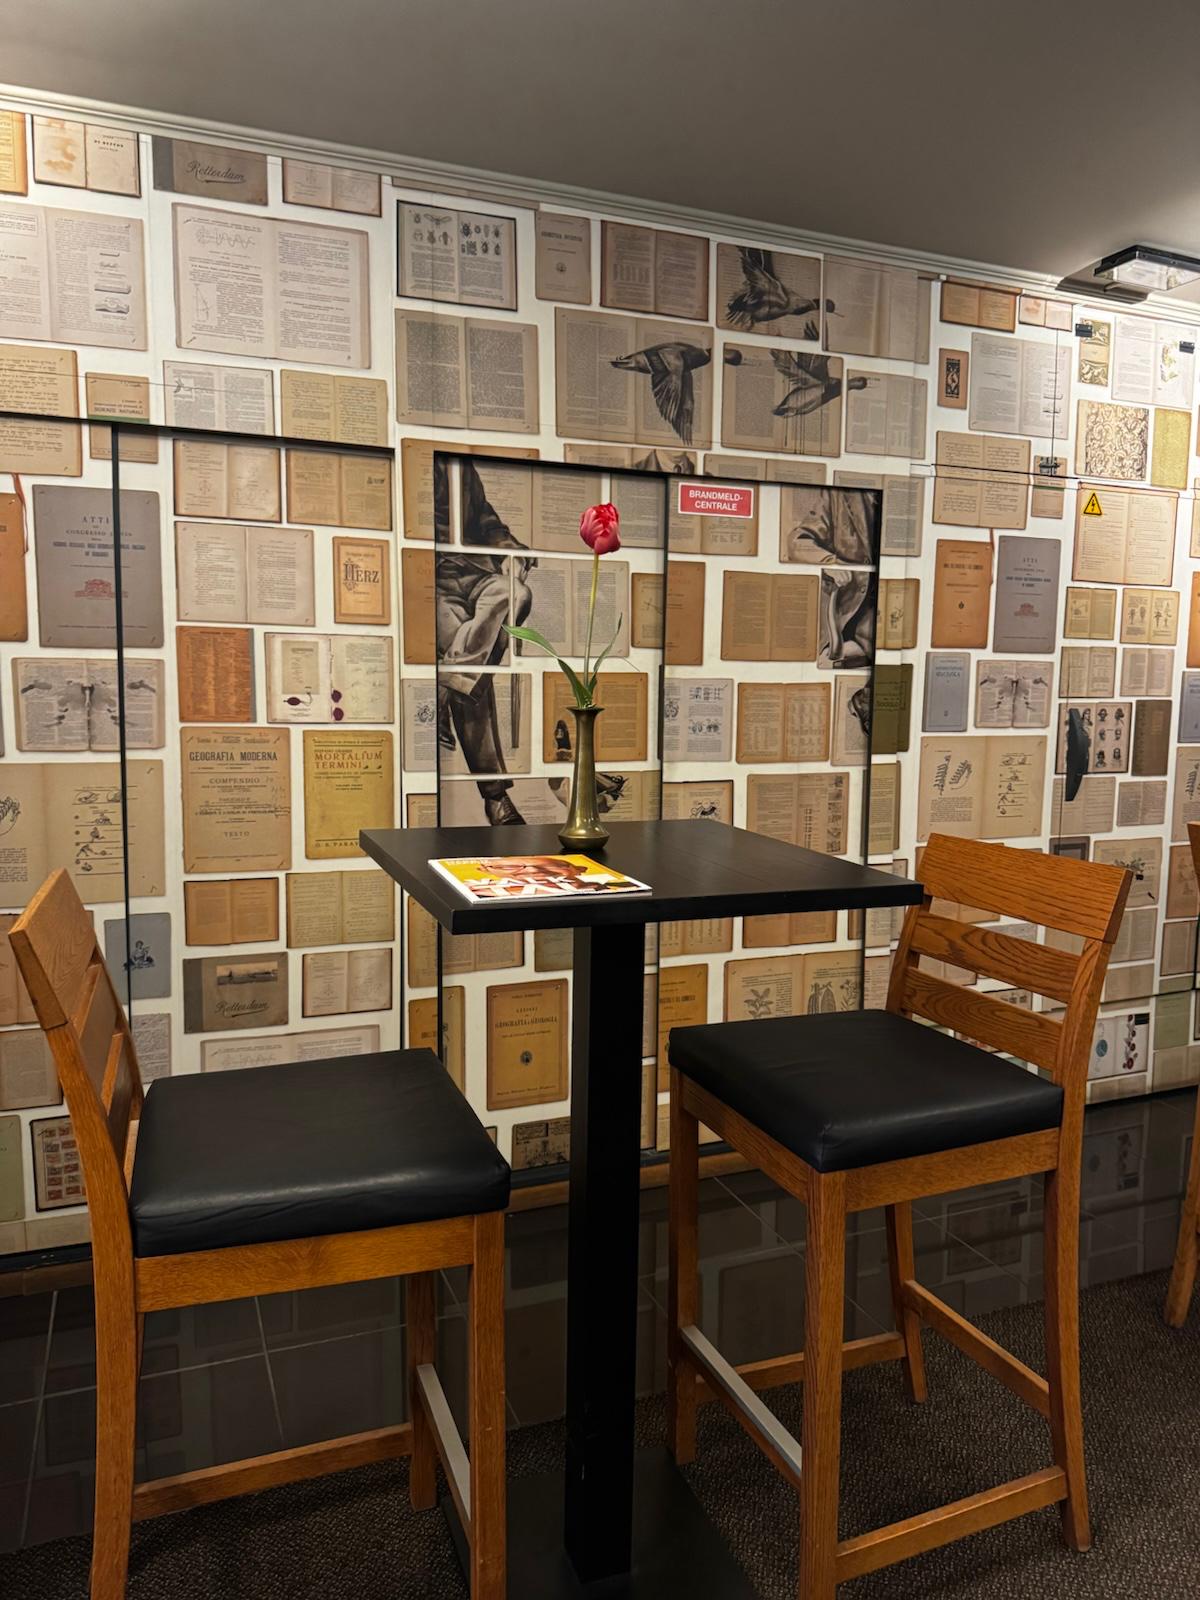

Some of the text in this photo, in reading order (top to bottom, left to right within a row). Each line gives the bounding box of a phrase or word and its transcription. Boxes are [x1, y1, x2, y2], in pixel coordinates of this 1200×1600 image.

[186, 160, 246, 183] Rotterdam
[689, 489, 743, 501] BRANDMELD-
[694, 500, 738, 511] CENTRALE
[189, 751, 278, 761] GEOGRAFIA MODERNA
[314, 750, 383, 761] MORTALIUM
[314, 761, 362, 769] TERMINI
[209, 777, 260, 785] COMPENDIO
[464, 876, 577, 886] VALK
